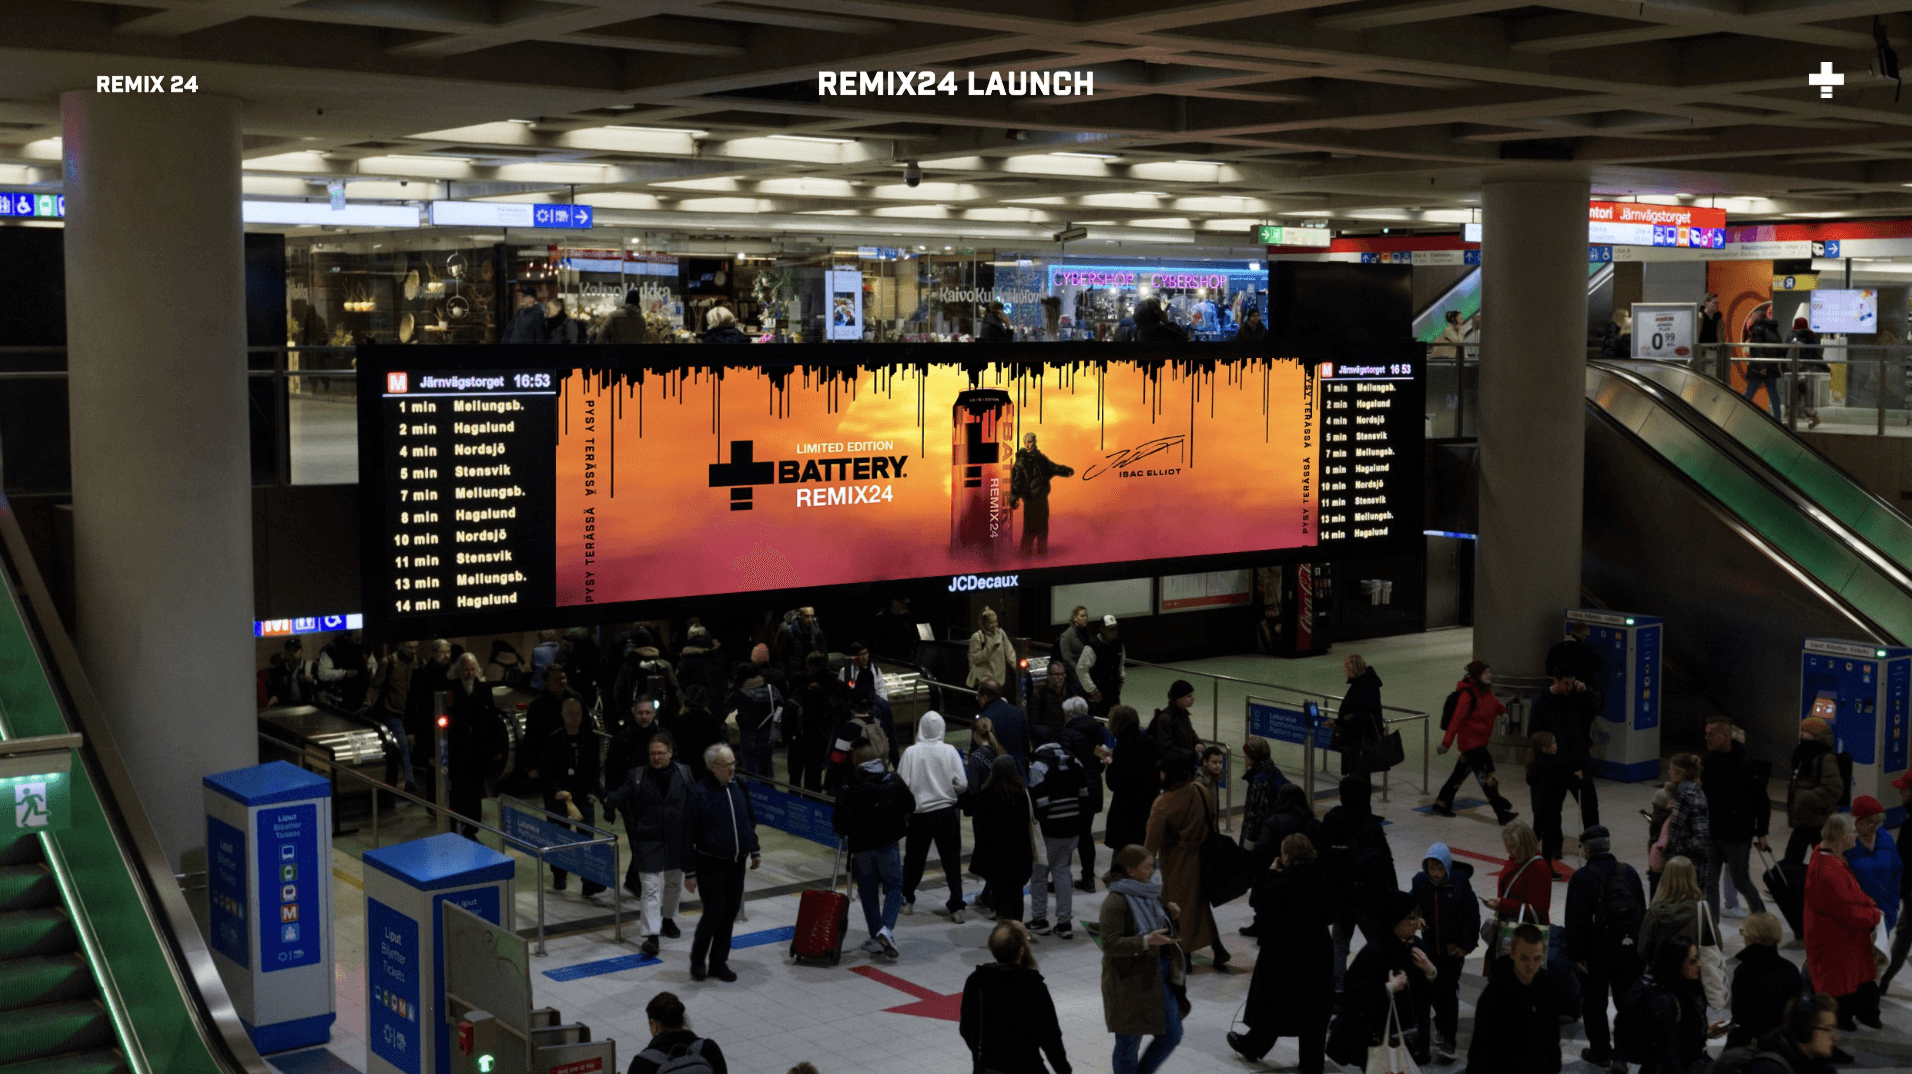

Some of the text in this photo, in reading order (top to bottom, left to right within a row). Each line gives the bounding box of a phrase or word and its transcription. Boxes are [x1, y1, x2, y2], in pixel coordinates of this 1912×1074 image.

[1620, 207, 1691, 225] Järnvägstorget
[1053, 271, 1135, 287] CYBERSHOP
[1151, 273, 1228, 290] CYBERSHOP
[1651, 333, 1676, 351] 0 99
[1339, 365, 1386, 376] Järnvägstorget
[420, 376, 505, 390] Järnvägstorget
[513, 374, 551, 388] 16:53
[1327, 383, 1397, 394] 1 min Mellungsb.
[400, 400, 525, 414] 1 min Mellungsb.
[1326, 399, 1391, 410] 2 min Hagalund
[400, 421, 515, 436] 2 min Hagalund
[1326, 415, 1385, 426] 4 min Nordsjö
[1326, 431, 1388, 442] 5 min Stensvik
[400, 443, 506, 457] 4 min Nordsjö
[585, 400, 597, 496] PYSY TERÄSSÄ
[796, 441, 894, 454] LIMITED EDITION
[1326, 447, 1395, 458] 7 min Mellungsb.
[400, 464, 511, 480] 5 min Stensvik
[1147, 469, 1182, 477] ELLIOT
[1326, 463, 1390, 475] 8 min Hagalund
[1302, 457, 1311, 505] TERÄSSÄ
[1321, 480, 1384, 491] 10 min Nordsjö
[400, 485, 526, 502] 7 min Mellungsb.
[796, 485, 894, 508] REMIX24
[1321, 495, 1387, 507] 11 min Stensvik
[401, 507, 516, 524] 8 min Hagalund
[990, 478, 1000, 539] REMIX24
[1321, 511, 1394, 524] 13 min Mellungsb.
[394, 529, 507, 546] 10 min Nordsjö
[1321, 527, 1389, 540] 14 min Hagalund
[395, 550, 513, 568] 11 min Stensvik
[583, 507, 595, 603] PYSY TERÄSSÄ
[395, 571, 527, 590] 13 min Mellungsb.
[948, 575, 1019, 592] JCDecaux
[396, 592, 518, 612] 14 min Hagalund
[278, 814, 297, 822] Liput
[385, 927, 402, 946] Liput
[382, 942, 406, 964] Biljetter
[383, 960, 406, 983] Tickets
